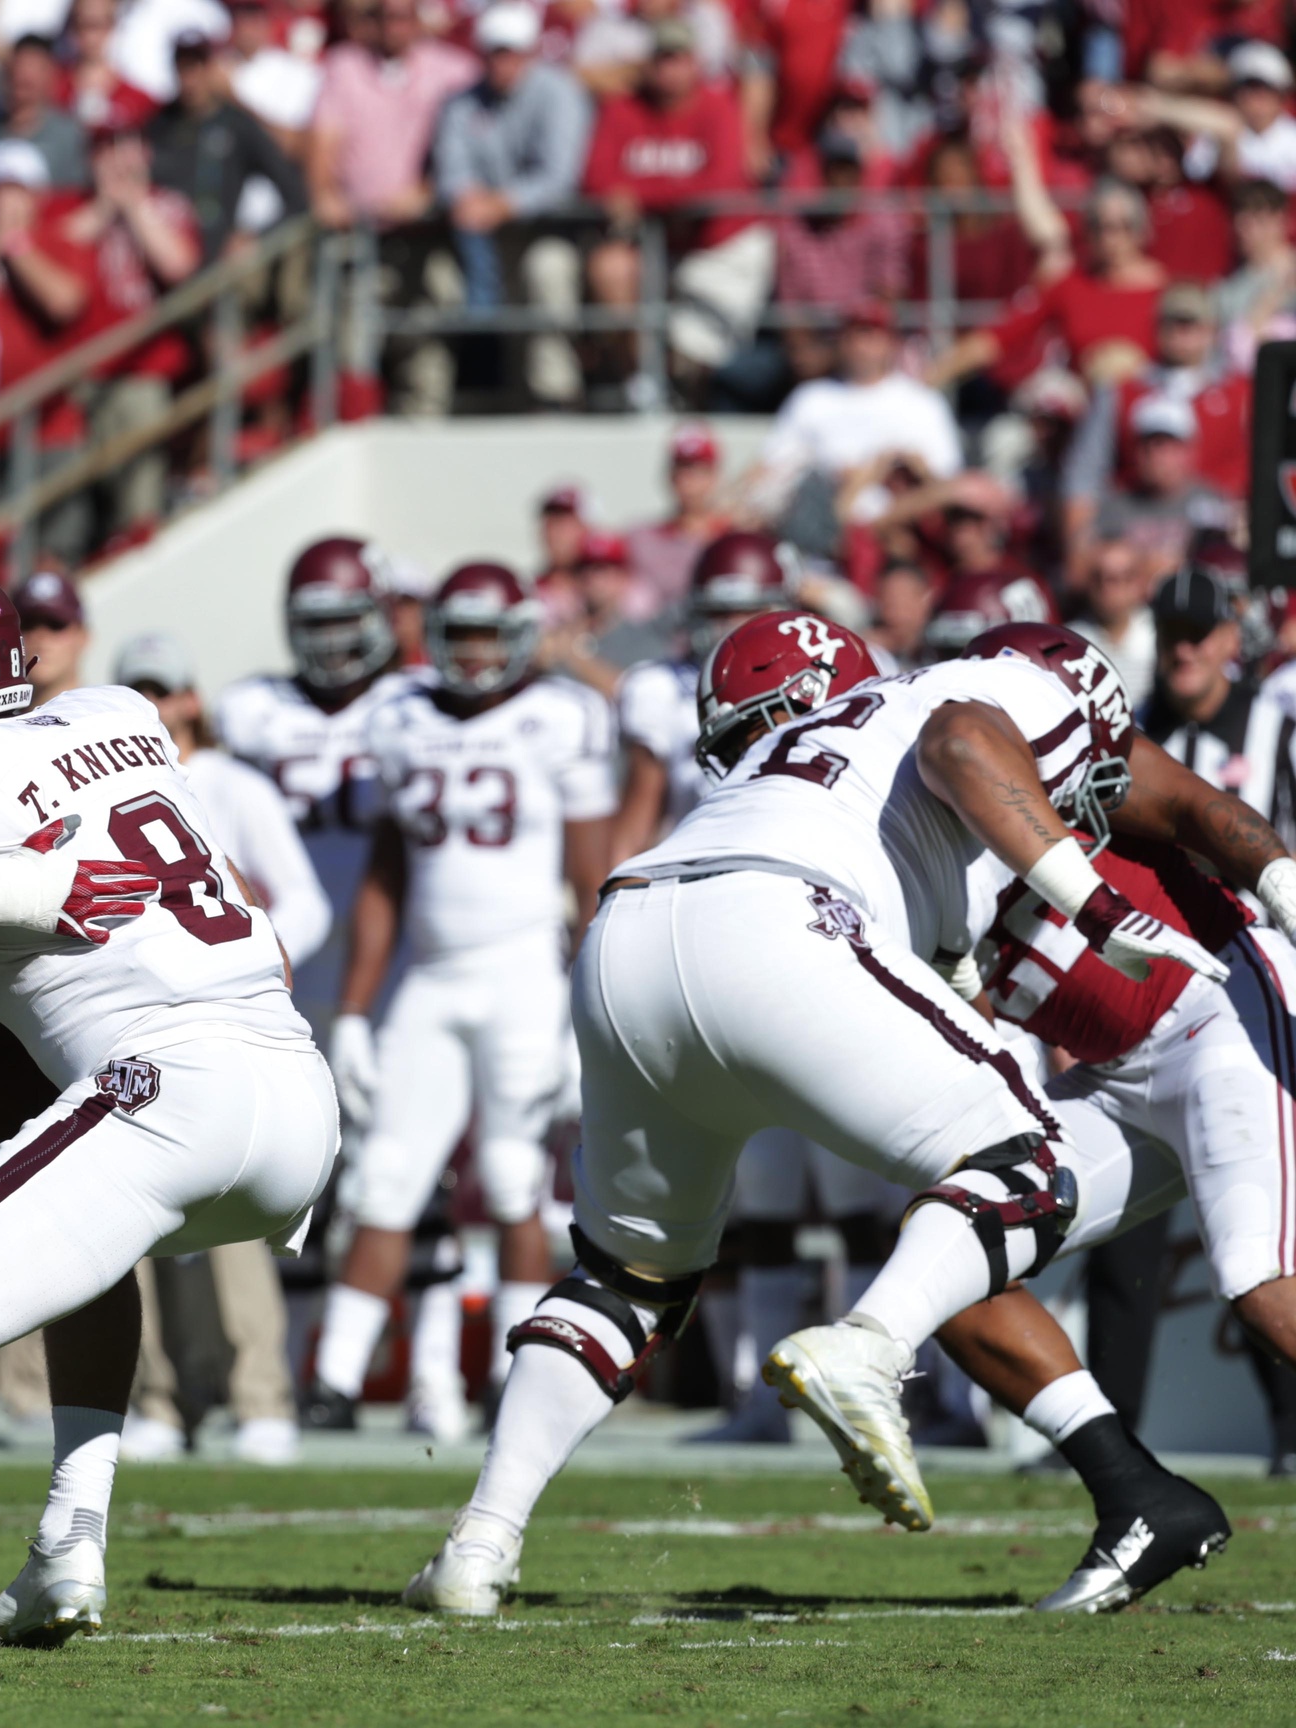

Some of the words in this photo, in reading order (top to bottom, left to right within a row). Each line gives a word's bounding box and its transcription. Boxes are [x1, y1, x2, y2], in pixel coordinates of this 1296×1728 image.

[10, 647, 21, 678] 8
[17, 780, 60, 824] T.
[404, 767, 517, 847] 33
[107, 790, 253, 946] 8
